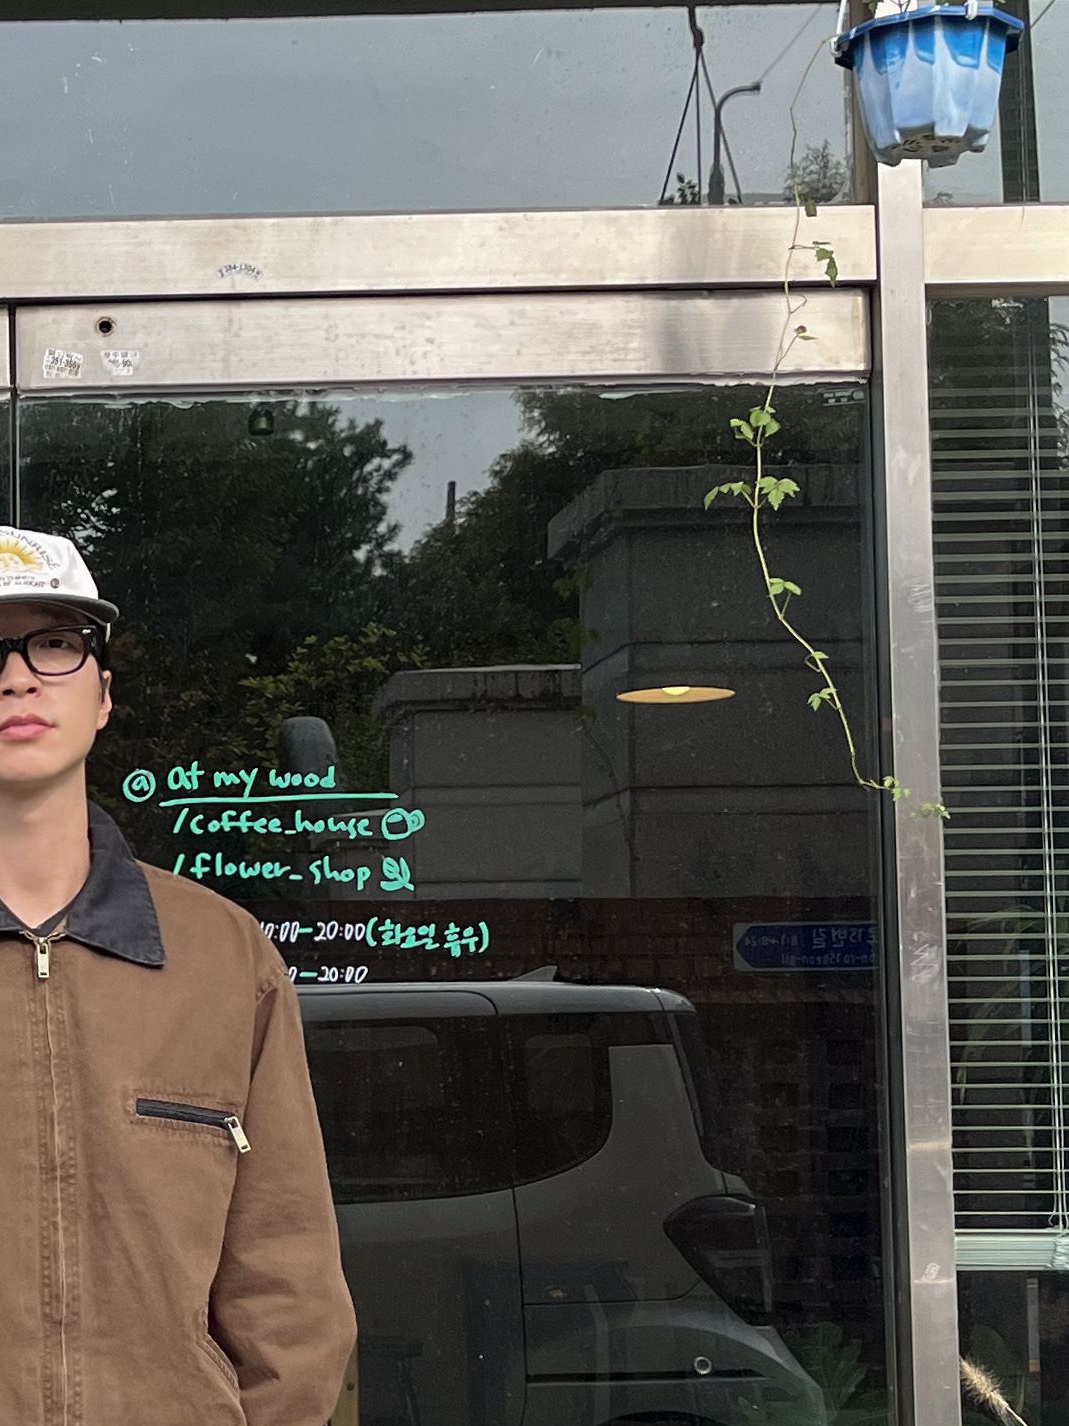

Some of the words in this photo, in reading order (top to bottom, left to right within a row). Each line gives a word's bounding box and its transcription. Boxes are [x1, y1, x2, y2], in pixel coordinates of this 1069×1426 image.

[167, 761, 205, 791] at
[214, 767, 259, 799] my
[268, 765, 336, 789] wood
